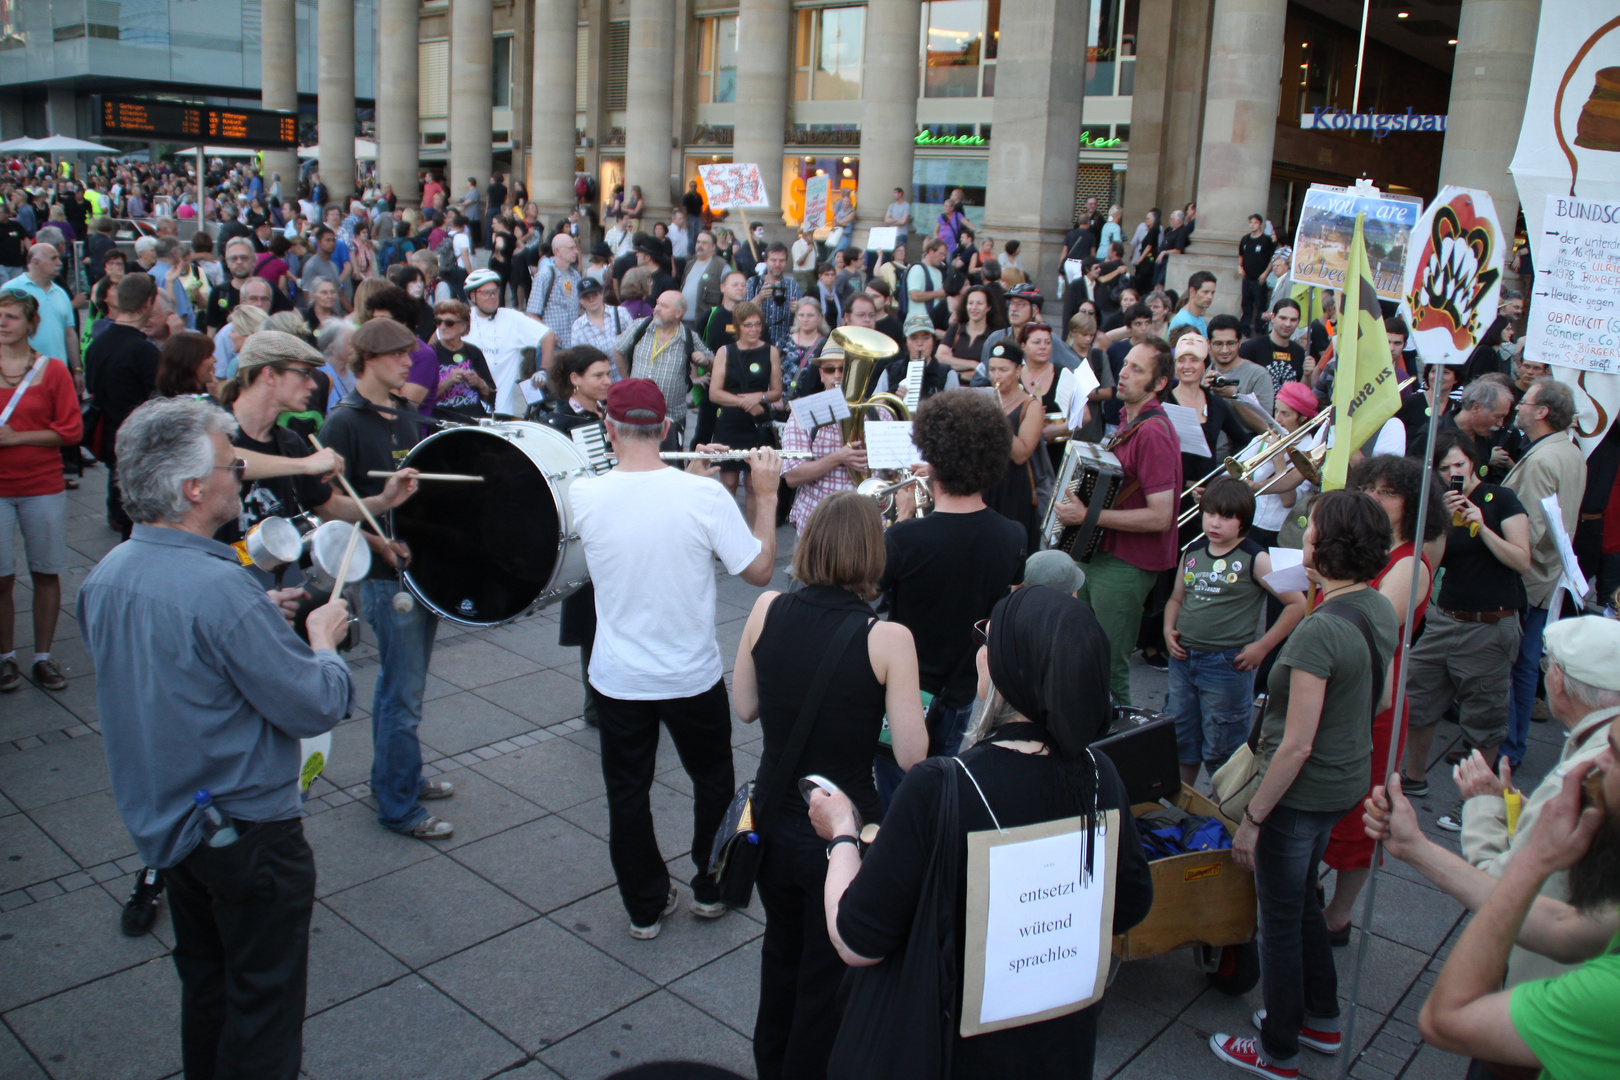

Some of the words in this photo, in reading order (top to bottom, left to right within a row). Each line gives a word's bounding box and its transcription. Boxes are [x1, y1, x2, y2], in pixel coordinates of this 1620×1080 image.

[914, 129, 985, 146] lumen
[1080, 130, 1121, 148] her
[1376, 204, 1407, 221] are
[1560, 230, 1580, 245] der
[1296, 261, 1315, 276] so
[1551, 269, 1575, 281] 1978
[1550, 287, 1582, 303] Heute:
[1586, 298, 1614, 311] gegen
[1547, 311, 1605, 329] OBRIGKEIT
[1545, 324, 1585, 341] Gönner
[1019, 881, 1076, 904] entsetzt
[1019, 913, 1073, 938] wütend
[1008, 945, 1078, 974] sprachlos
